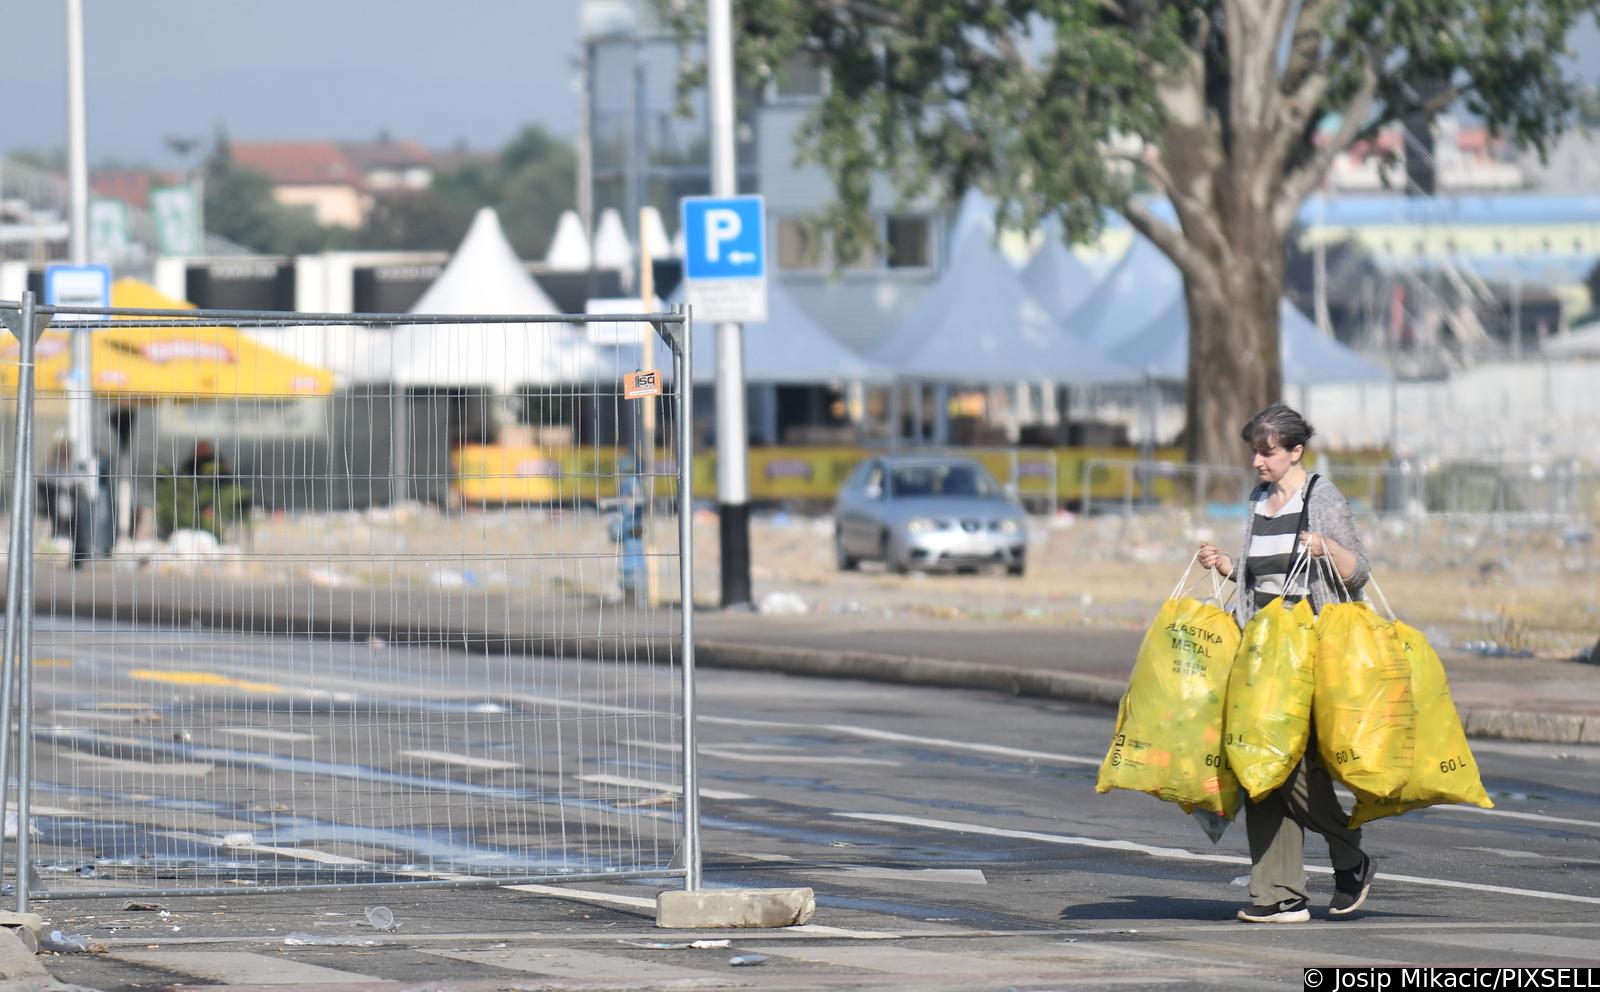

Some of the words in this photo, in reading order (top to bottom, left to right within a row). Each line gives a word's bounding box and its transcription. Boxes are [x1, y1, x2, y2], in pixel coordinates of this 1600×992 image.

[704, 208, 742, 262] P
[1165, 623, 1223, 645] PLASTIKA
[1171, 637, 1212, 658] METAL
[1205, 753, 1221, 768] 60
[1336, 750, 1348, 765] 60
[1350, 748, 1360, 761] L
[1440, 758, 1456, 774] 60
[1458, 755, 1466, 768] L
